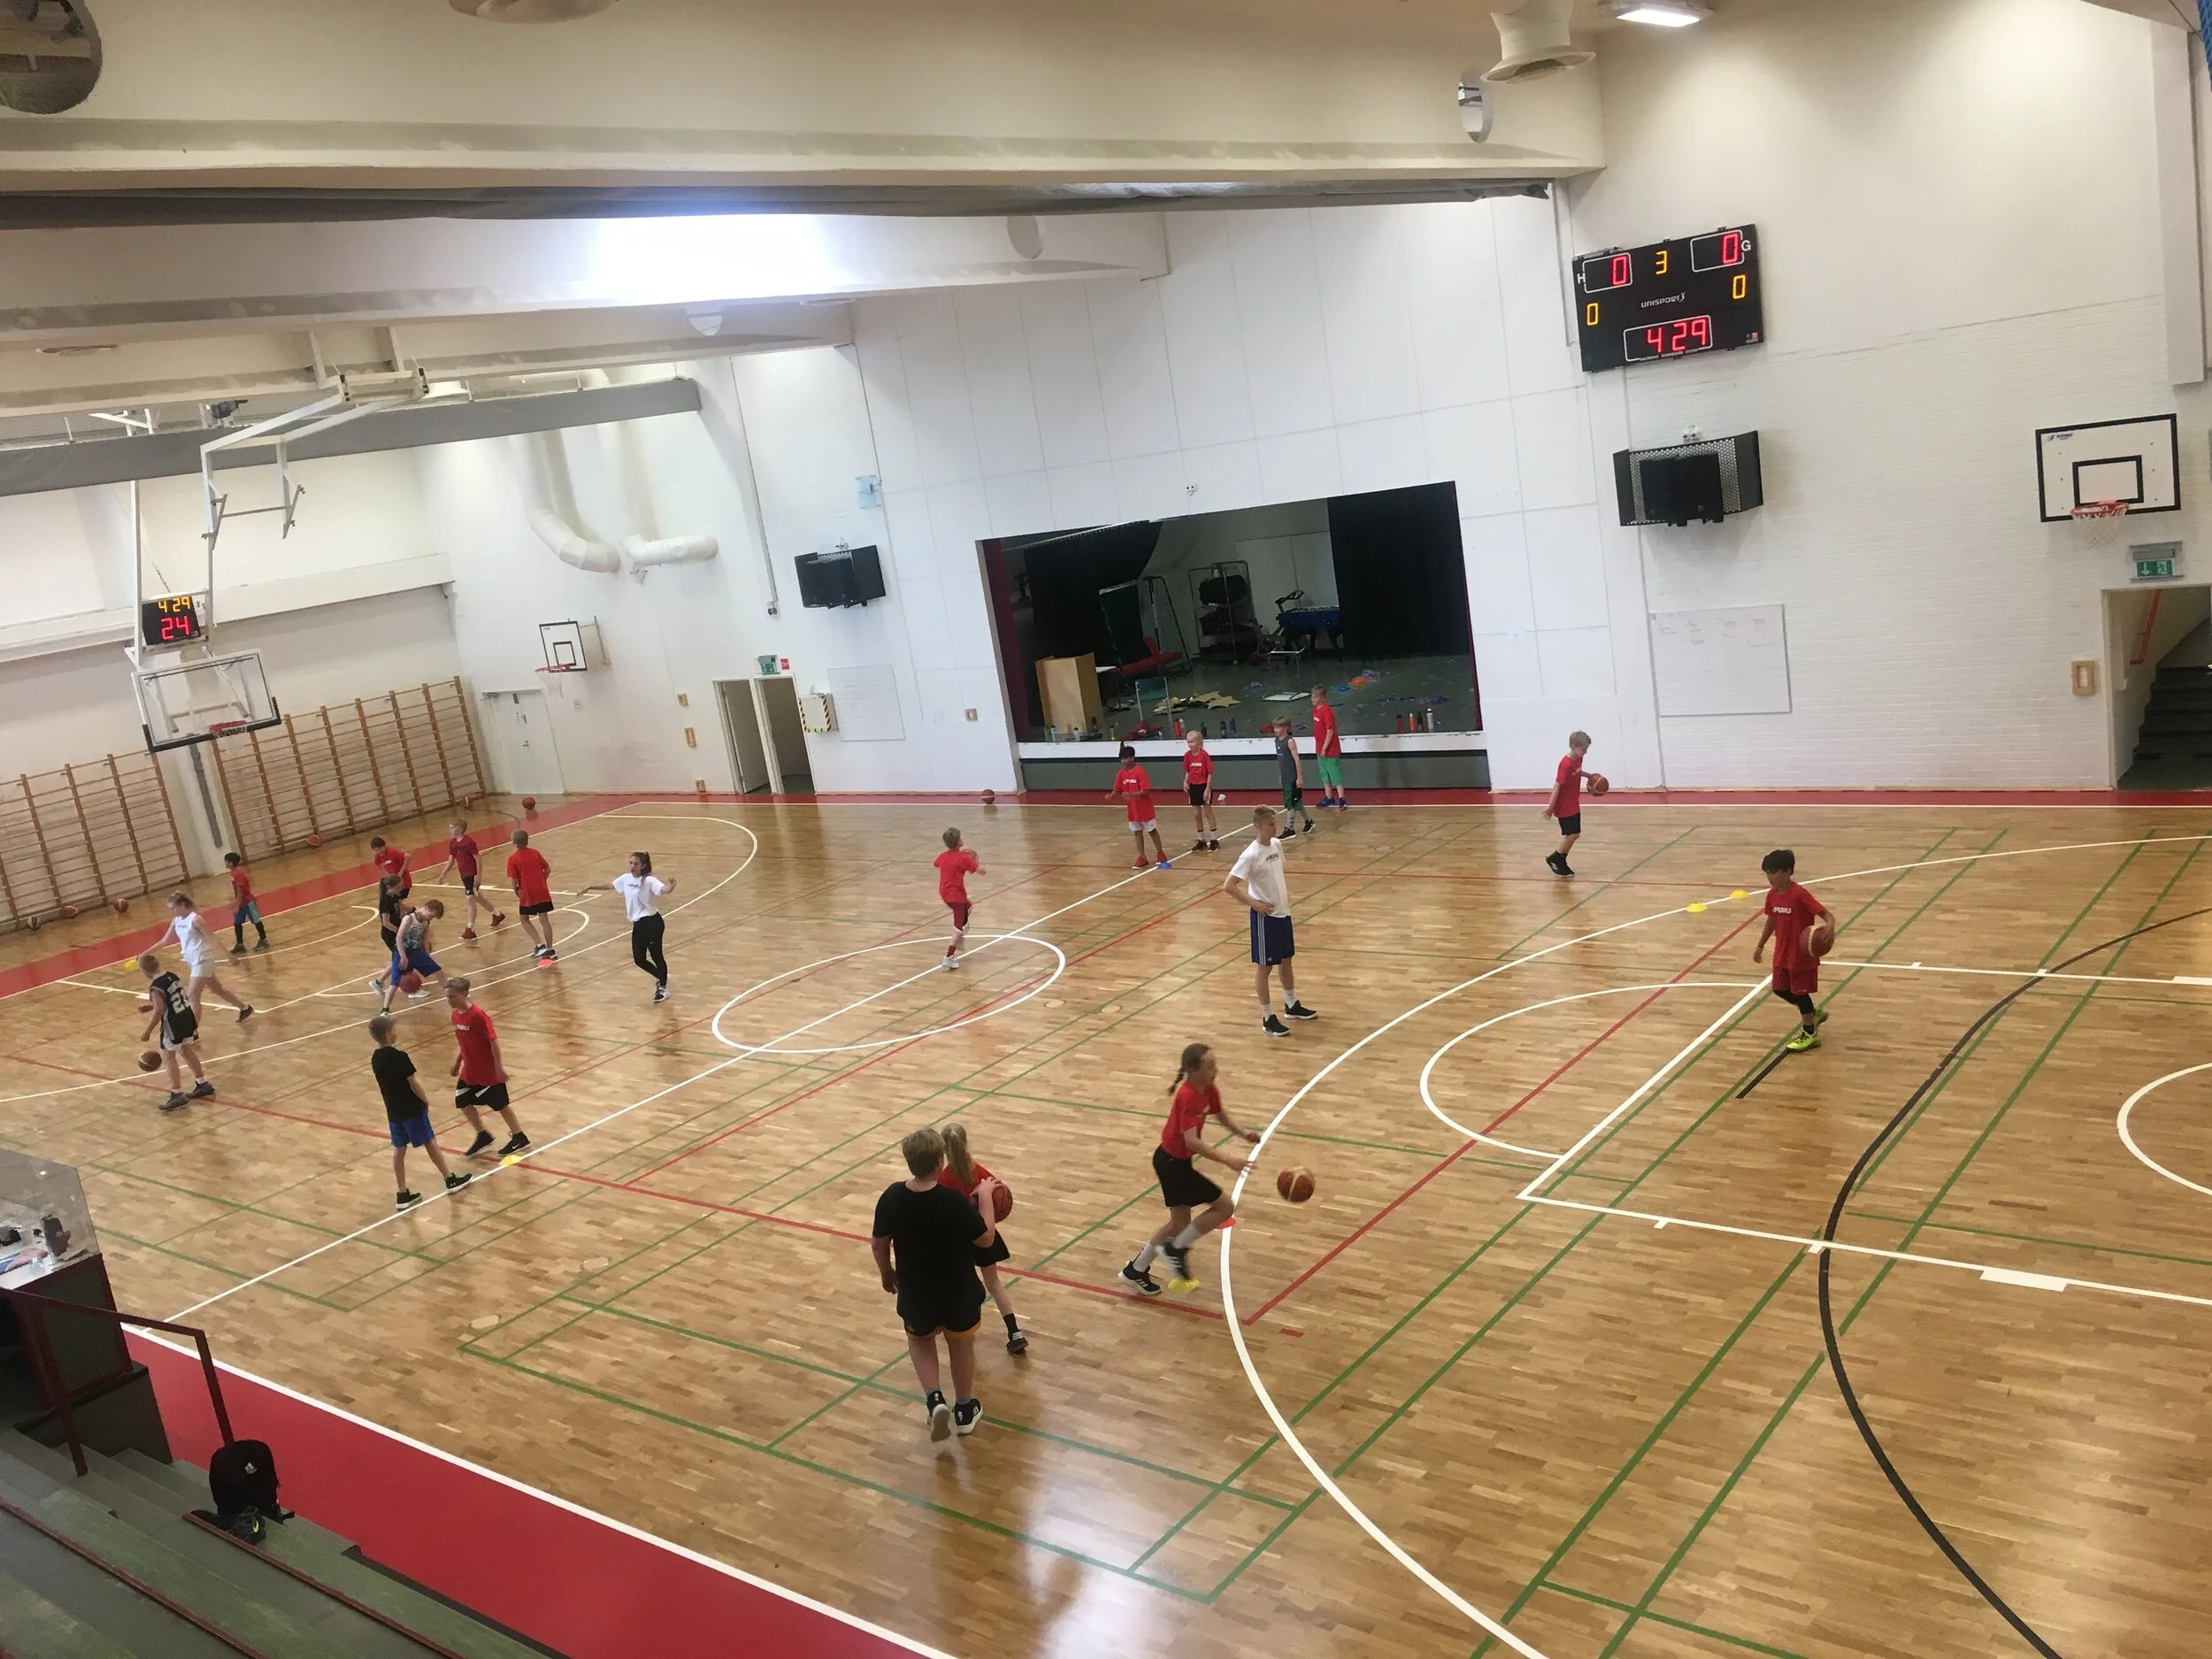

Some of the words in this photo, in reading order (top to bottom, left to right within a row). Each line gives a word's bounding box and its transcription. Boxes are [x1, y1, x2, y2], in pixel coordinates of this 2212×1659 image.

[1722, 233, 1739, 265] 0
[1741, 240, 1752, 254] G
[1612, 255, 1628, 286] 0
[1655, 250, 1668, 275] 3
[1577, 273, 1586, 284] H
[1732, 274, 1747, 300] 0
[1641, 294, 1682, 308] UNISPORT
[1586, 303, 1599, 326] 0
[161, 616, 190, 641] 24
